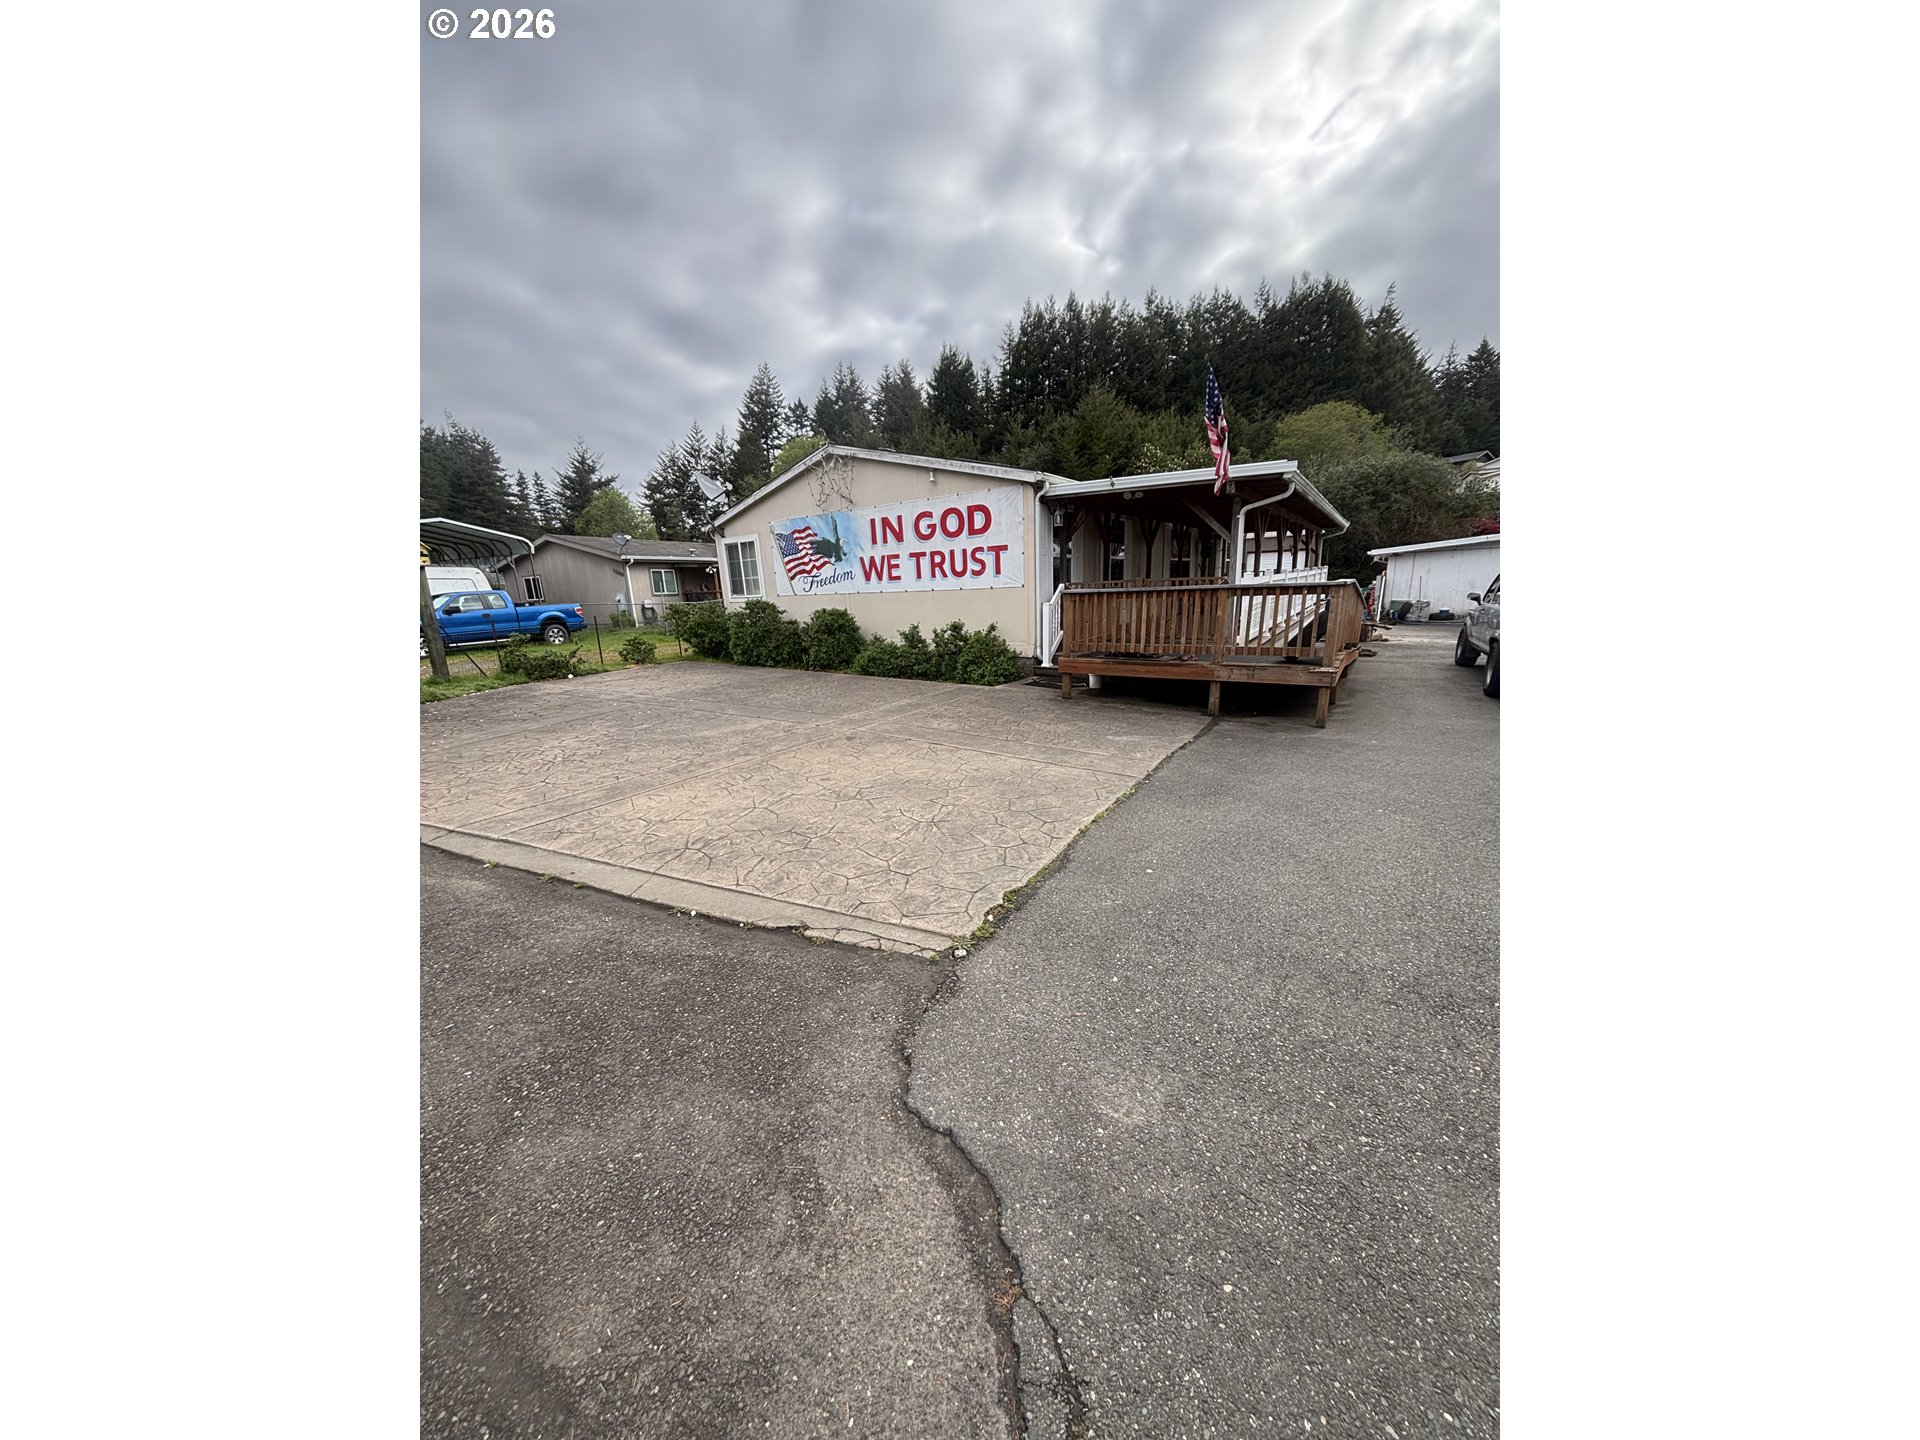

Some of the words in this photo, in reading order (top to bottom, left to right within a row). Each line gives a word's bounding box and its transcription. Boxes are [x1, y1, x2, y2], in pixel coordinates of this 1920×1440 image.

[870, 515, 904, 545] IN
[913, 504, 992, 541] GOD
[799, 568, 856, 592] Freedom
[860, 553, 902, 583] WE
[909, 544, 1009, 580] TRUST
